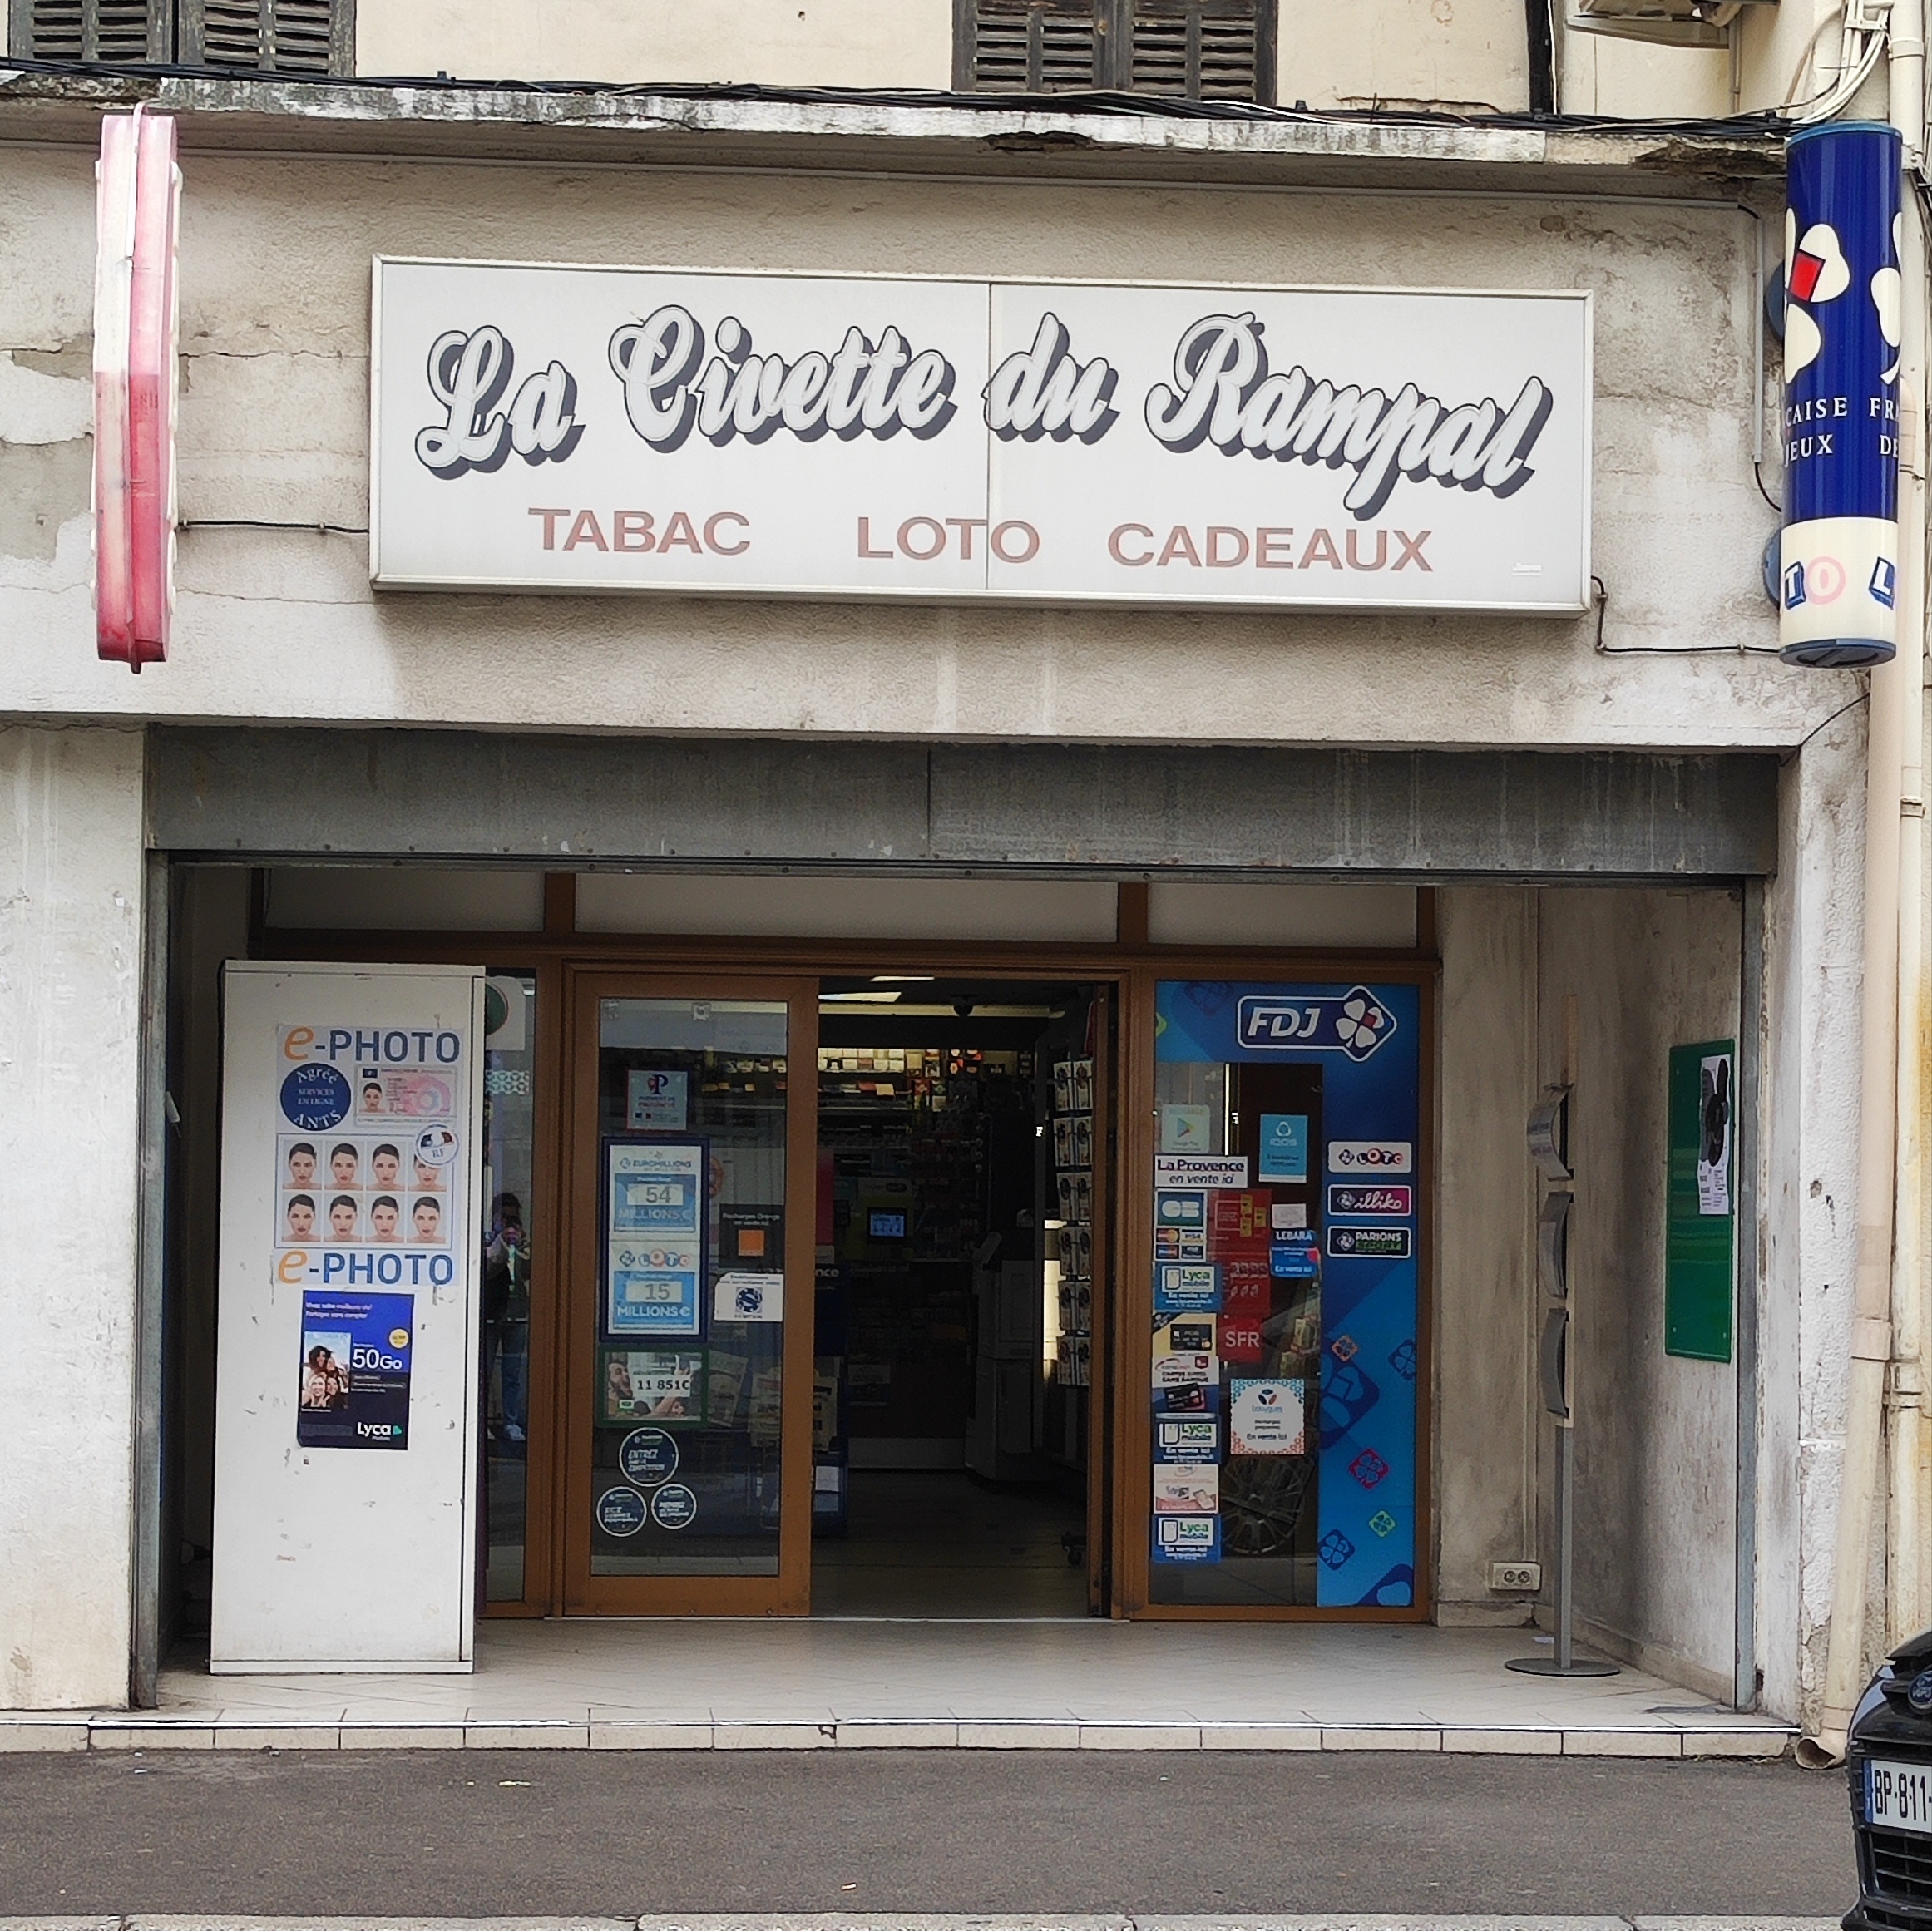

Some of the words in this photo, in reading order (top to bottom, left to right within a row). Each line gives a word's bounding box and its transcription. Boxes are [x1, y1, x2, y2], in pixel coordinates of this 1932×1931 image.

[415, 323, 586, 481] La
[608, 304, 959, 454] Civette
[981, 312, 1120, 446] du
[1144, 311, 1554, 521] Rampal
[528, 508, 750, 556] TABAC
[857, 516, 1040, 565] LOTO
[1108, 522, 1433, 572] CADEAUX
[1248, 1007, 1322, 1038] FDJ
[284, 1026, 461, 1063] e-PHOTO
[293, 1109, 342, 1128] ANTS
[1356, 1148, 1404, 1165] LOTO
[1157, 1158, 1175, 1171] La
[1177, 1159, 1245, 1173] Provence
[1169, 1175, 1184, 1184] en
[1187, 1173, 1219, 1184] vente
[645, 1186, 672, 1203] 54
[1353, 1191, 1403, 1210] illiko
[1275, 1231, 1313, 1241] LEBARA
[1356, 1232, 1402, 1242] PARIONS
[638, 1248, 690, 1267] LOTO
[278, 1250, 454, 1286] e-PHOTO
[1182, 1269, 1211, 1281] Lyca
[645, 1283, 670, 1301] 15
[617, 1306, 679, 1317] MILLIONS
[1225, 1331, 1260, 1349] SFR
[637, 1380, 652, 1390] 11
[357, 1421, 392, 1437] Lyca
[1181, 1424, 1212, 1435] Lyca
[1179, 1522, 1209, 1533] Lyca
